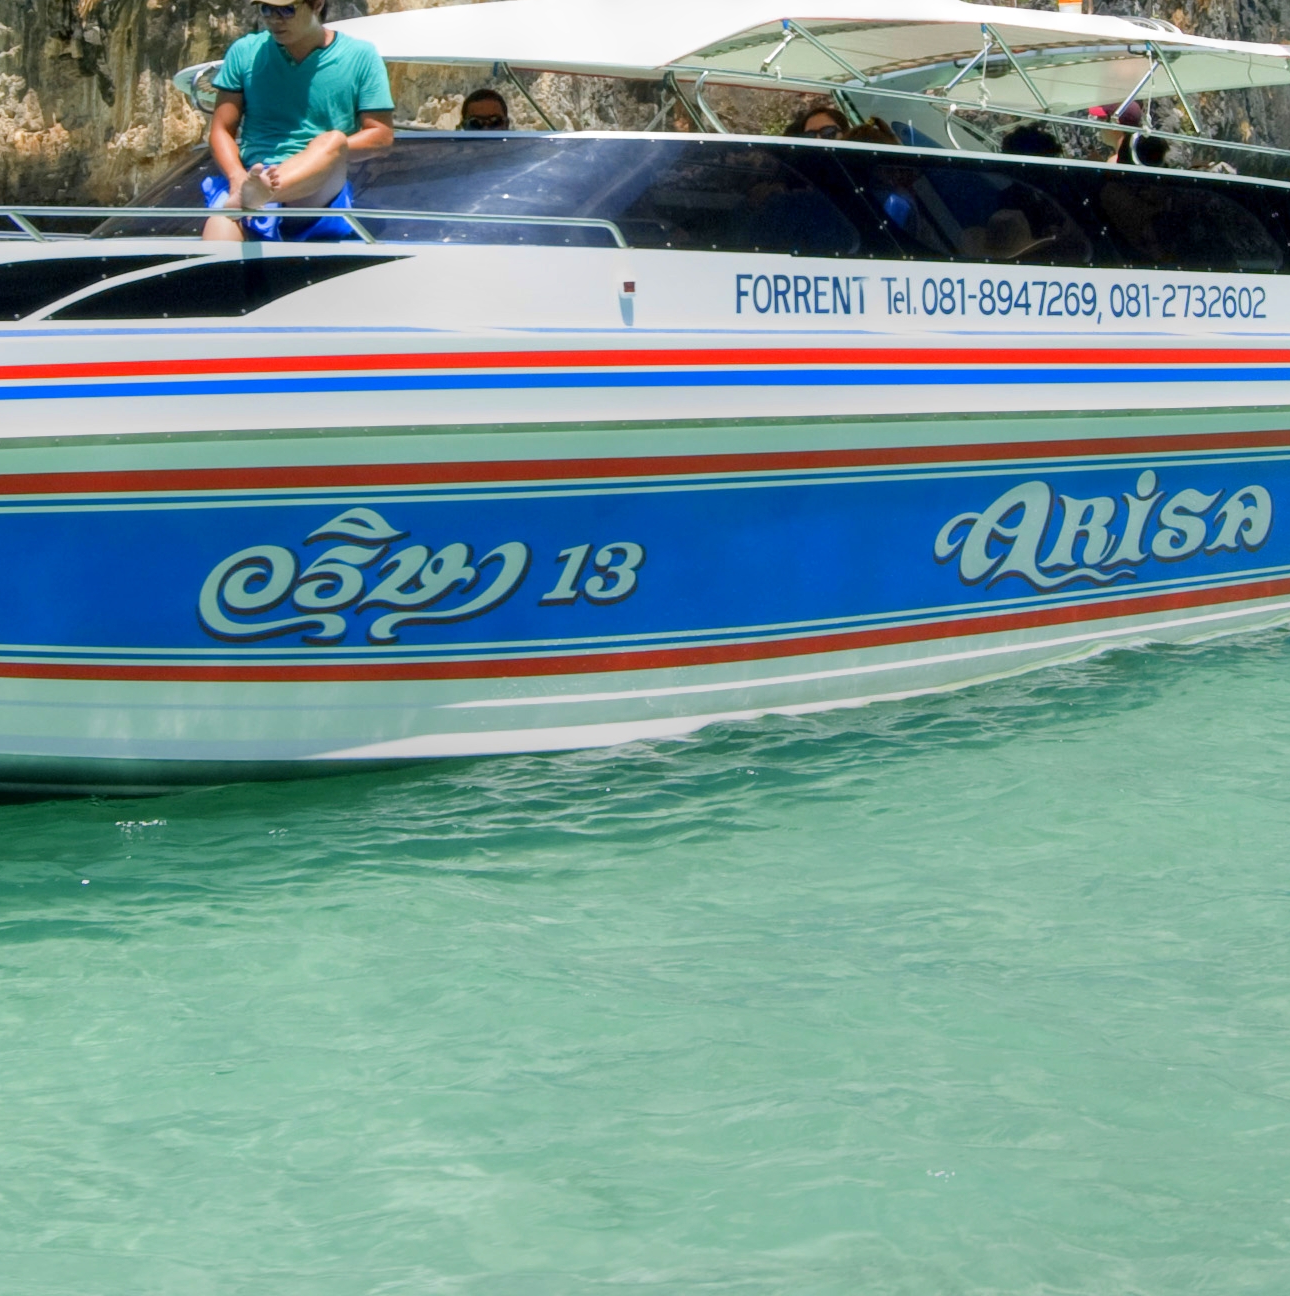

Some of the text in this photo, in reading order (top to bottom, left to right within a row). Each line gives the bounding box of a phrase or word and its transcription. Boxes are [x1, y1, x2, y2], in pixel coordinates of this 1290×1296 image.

[735, 273, 869, 315] FORRENT
[1109, 283, 1267, 319] 081-2732602
[538, 541, 646, 606] 13
